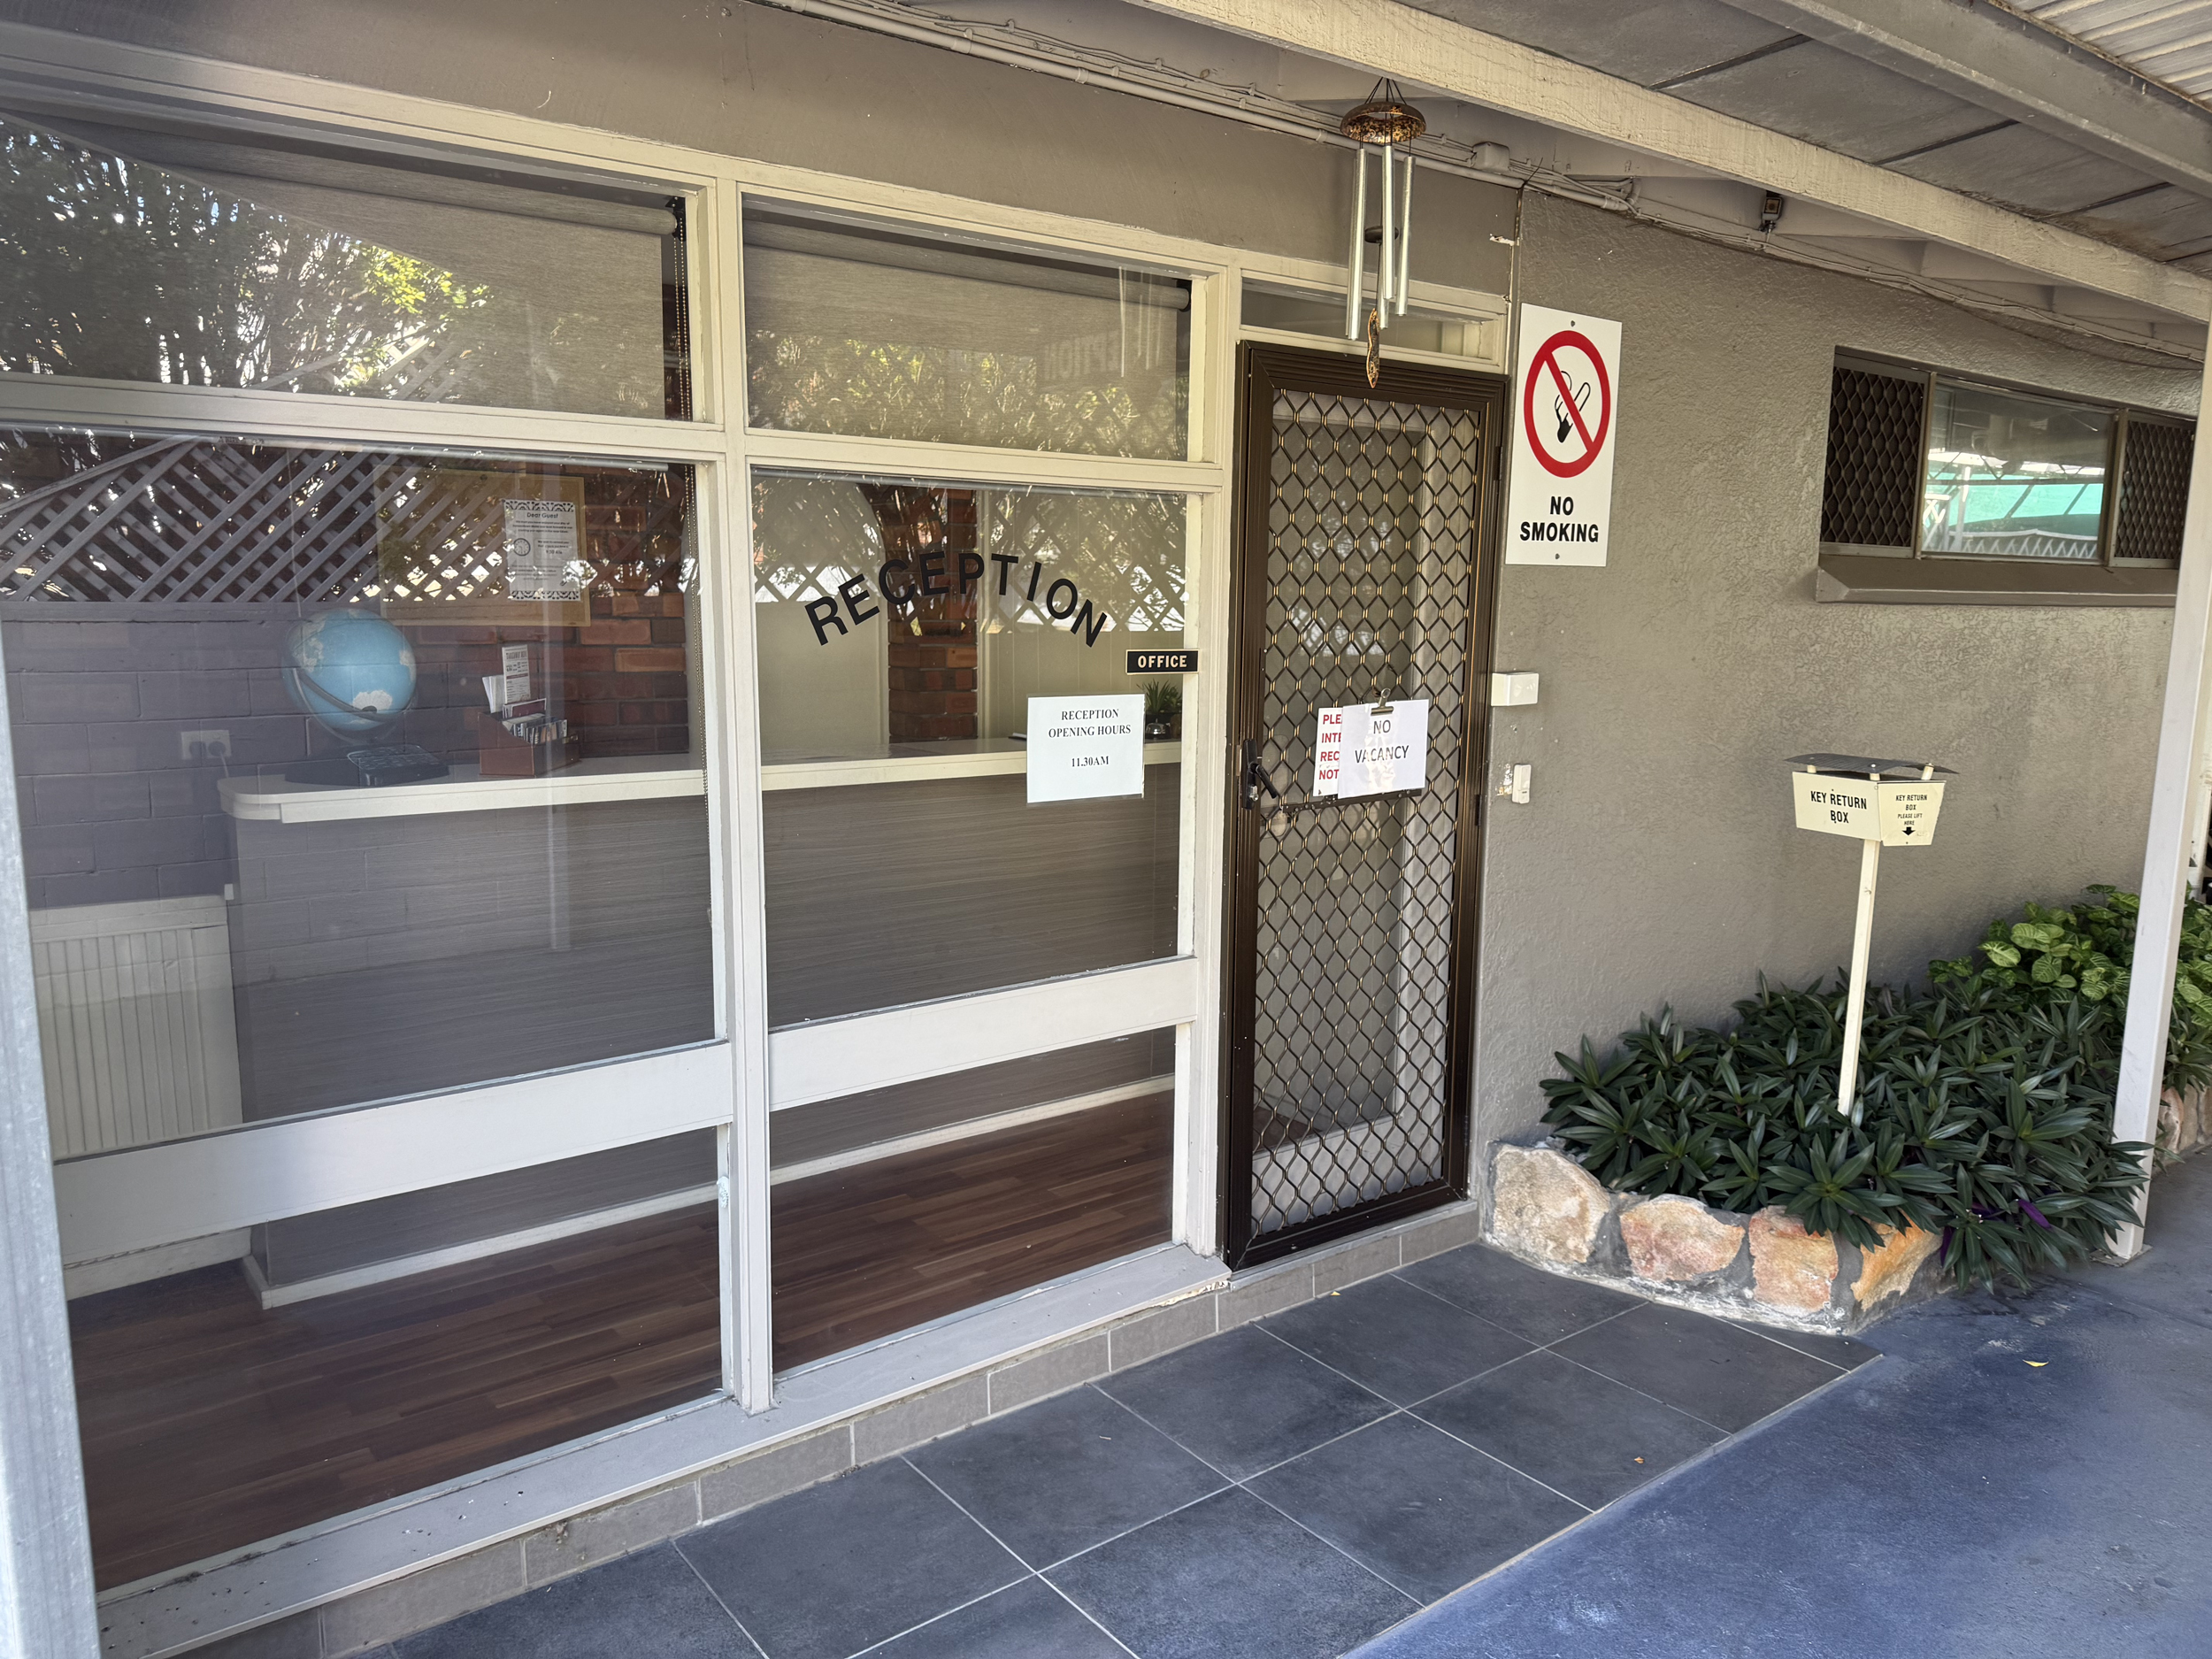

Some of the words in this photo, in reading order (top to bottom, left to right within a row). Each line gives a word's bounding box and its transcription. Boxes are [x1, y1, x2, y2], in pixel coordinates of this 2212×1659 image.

[1549, 495, 1574, 516] NO
[1519, 521, 1599, 542] SMOKING
[804, 550, 1108, 648] RECEPTION
[1137, 655, 1187, 669] OFFICE
[1061, 708, 1119, 721] RECEPTION
[1323, 714, 1342, 725] PLE
[1048, 726, 1095, 739] OPENING
[1097, 724, 1132, 737] HOURS
[1373, 719, 1391, 734] NO
[1320, 751, 1340, 762] REC
[1355, 745, 1409, 764] VACANCY
[1071, 756, 1110, 768] 11.30AM
[1318, 769, 1340, 780] NOT
[1810, 790, 1827, 804] KEY
[1830, 793, 1868, 810] RETURN
[1830, 810, 1849, 824] BOX
